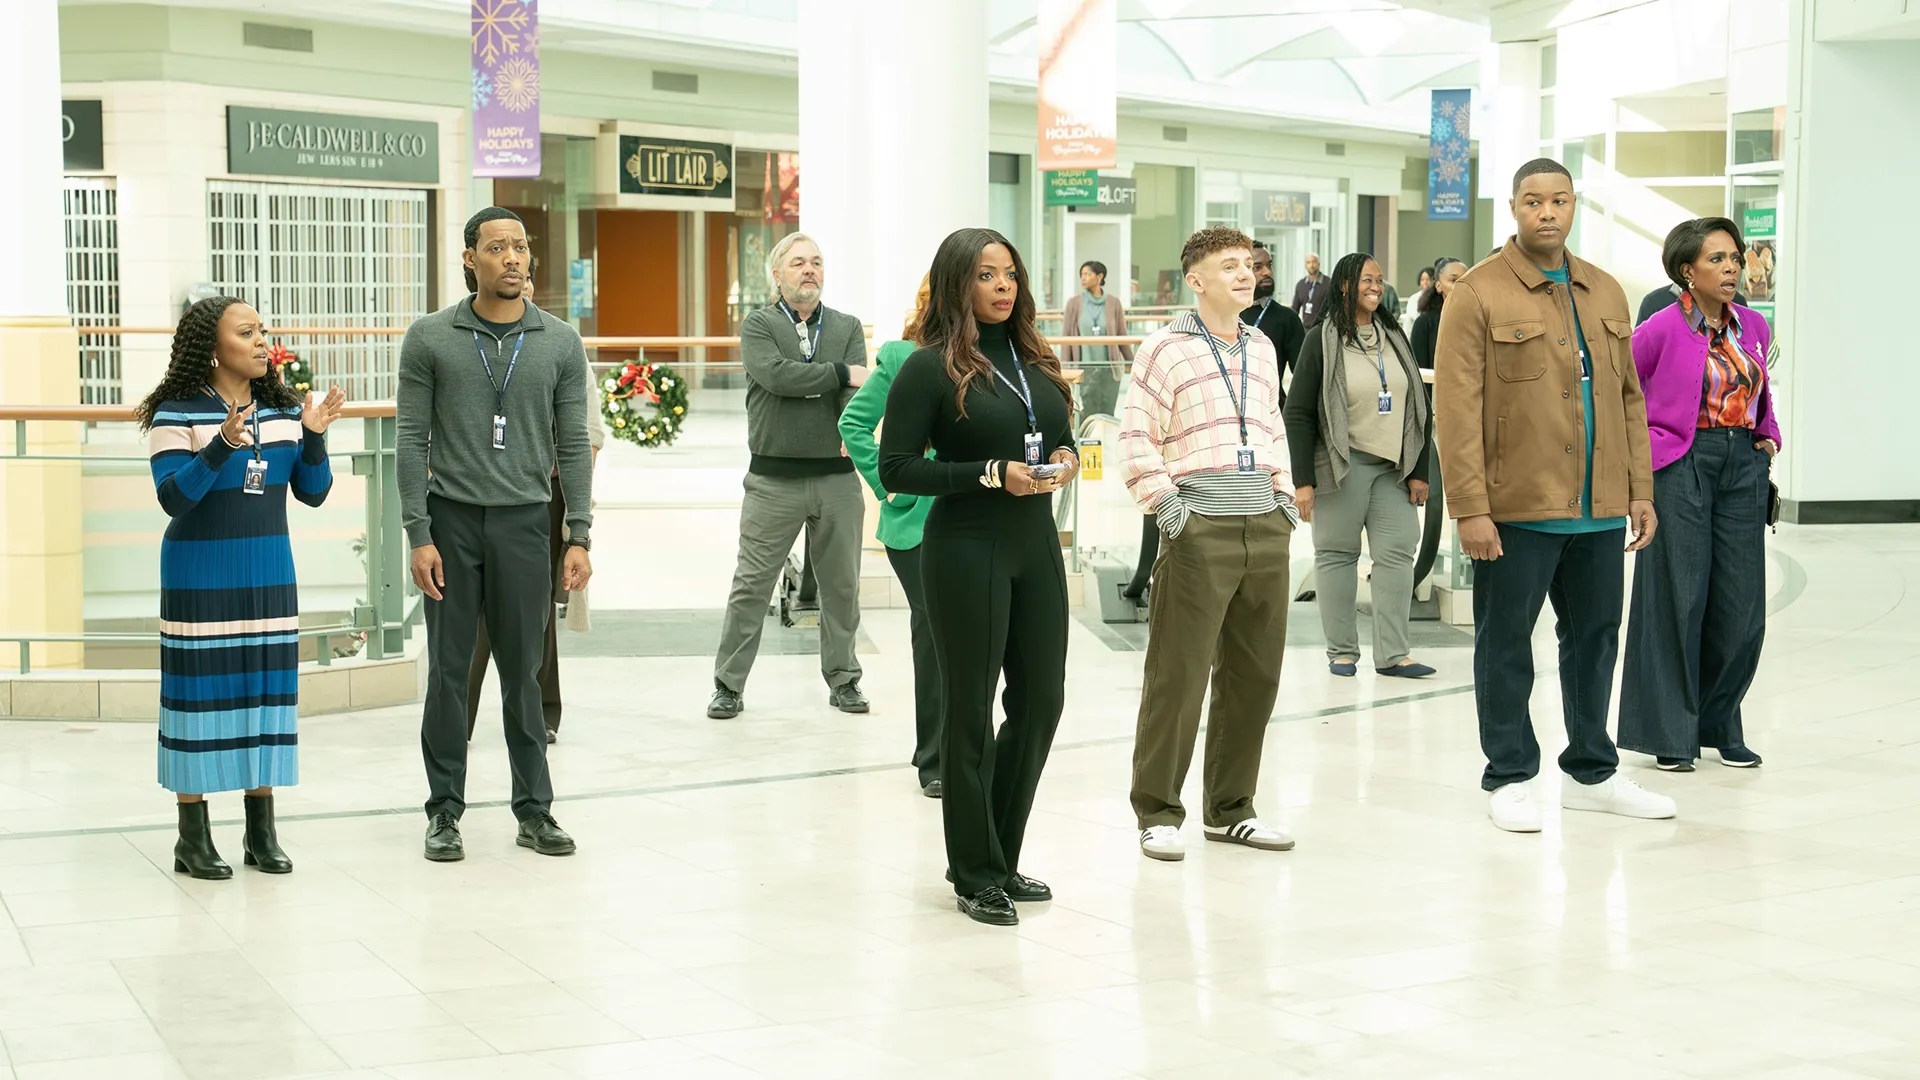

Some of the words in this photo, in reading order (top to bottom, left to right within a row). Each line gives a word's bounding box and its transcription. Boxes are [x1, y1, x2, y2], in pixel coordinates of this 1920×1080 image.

[487, 126, 524, 138] HAPPY
[1045, 126, 1106, 140] HOLIDAY
[479, 138, 534, 150] HOLIDAYS
[648, 151, 670, 183] LIT
[675, 153, 707, 185] LAIR
[1051, 178, 1093, 186] HOLIDAYS
